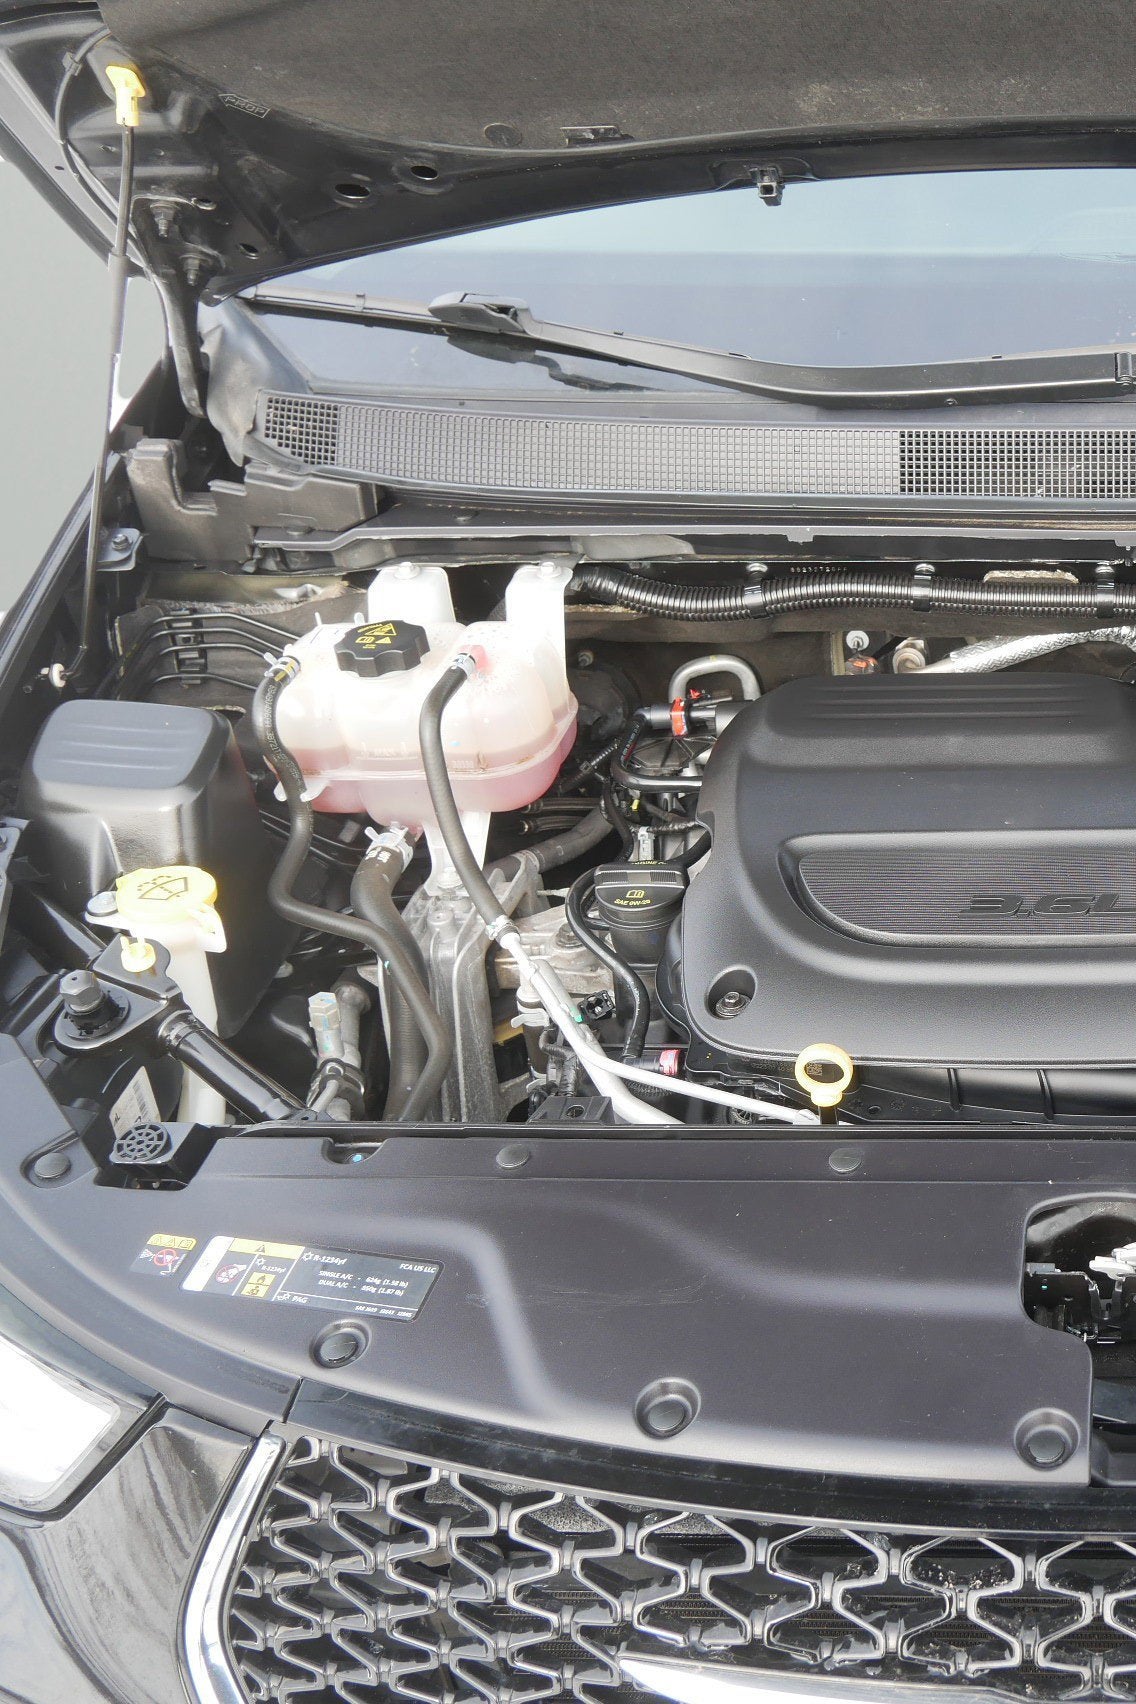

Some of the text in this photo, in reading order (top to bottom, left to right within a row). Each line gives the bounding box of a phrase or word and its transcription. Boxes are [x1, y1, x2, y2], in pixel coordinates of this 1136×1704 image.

[614, 898, 629, 906] SAE
[313, 1254, 348, 1265] R-1234yf
[400, 1263, 413, 1271] FCA
[424, 1266, 437, 1274] LLC
[319, 1270, 341, 1279] SINGLE
[340, 1273, 353, 1281] A/C
[318, 1279, 338, 1287] DUAL
[338, 1281, 349, 1289] A/C
[292, 1295, 309, 1304] PAG
